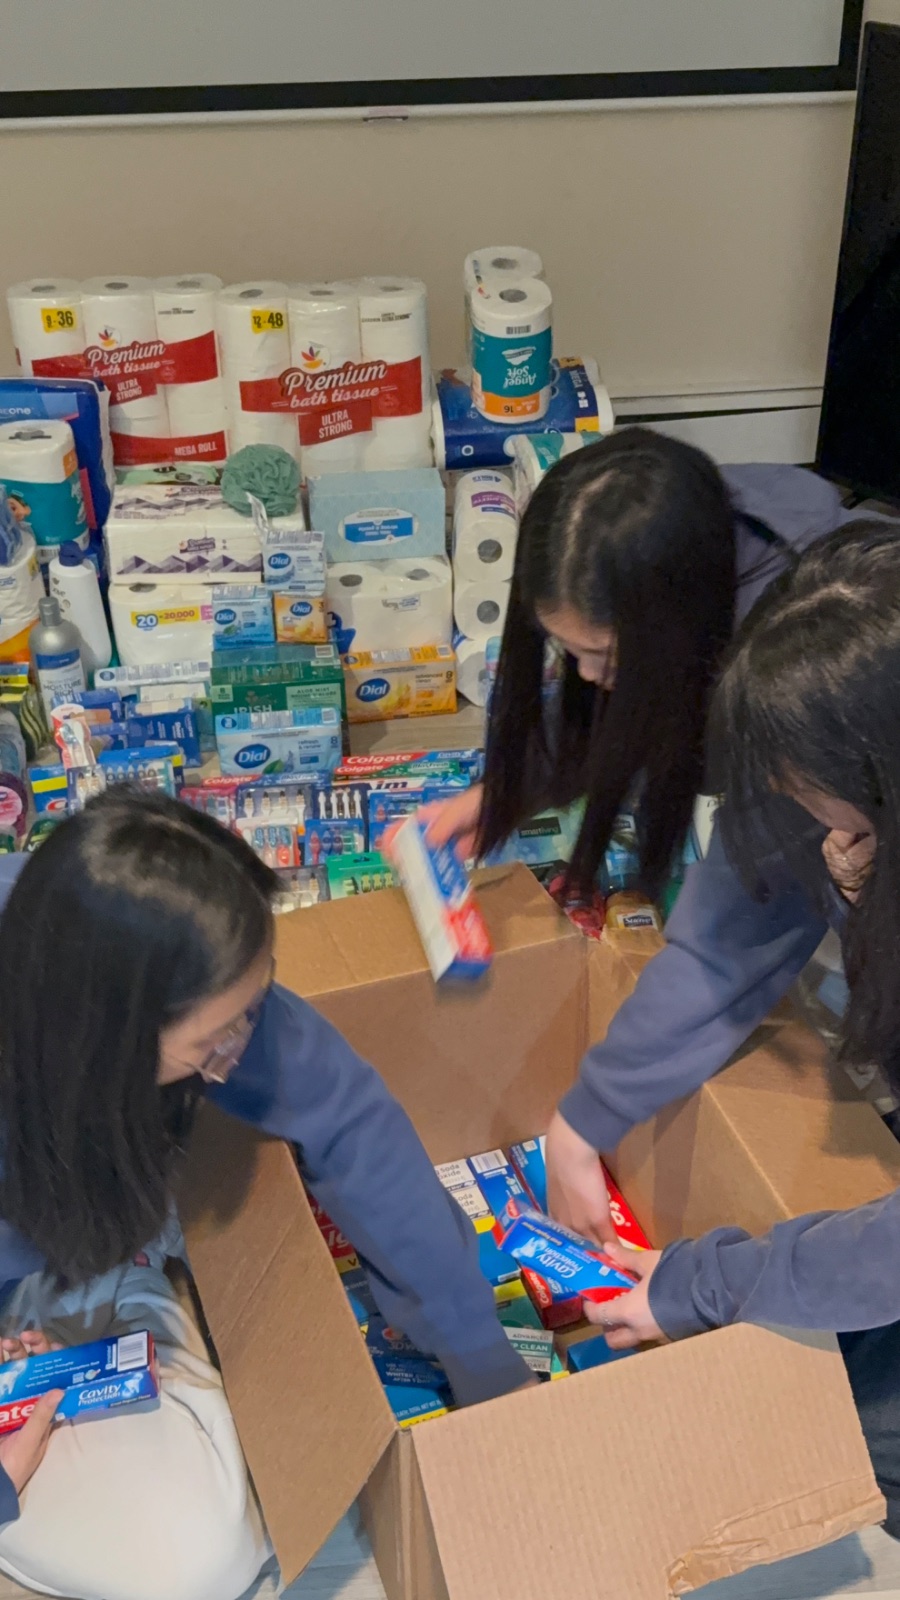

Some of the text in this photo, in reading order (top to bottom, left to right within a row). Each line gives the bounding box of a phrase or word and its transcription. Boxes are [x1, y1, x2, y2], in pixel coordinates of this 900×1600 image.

[57, 311, 74, 326] 36
[253, 312, 283, 327] 12 48
[87, 340, 166, 366] Premium
[93, 360, 161, 378] bath tissue
[507, 365, 530, 377] Soft
[116, 378, 139, 392] ULTRA
[284, 361, 388, 396] Premium
[503, 373, 536, 388] Angel
[116, 387, 142, 401] STRONG
[290, 385, 380, 408] bath tissue
[503, 405, 514, 413] 16
[321, 409, 349, 426] ULTRA
[318, 420, 353, 439] STRONG
[174, 441, 218, 456] MEGA ROLL
[270, 556, 289, 565] Dial
[216, 610, 235, 621] Dial
[292, 603, 311, 614] Dial
[136, 615, 157, 627] 20
[43, 679, 81, 690] MOISTURE
[359, 683, 388, 696] Dial
[233, 704, 272, 714] IRISH
[238, 749, 268, 763] Dial
[347, 753, 414, 765] Colgate
[336, 764, 384, 773] Colgate
[204, 776, 252, 785] Colgate
[375, 780, 408, 790] im
[457, 1193, 473, 1201] oda
[536, 1248, 577, 1279] Cavity
[528, 1272, 550, 1305] Colgate
[512, 1333, 549, 1341] ADVANCED
[519, 1343, 548, 1352] CLEAN
[78, 1383, 122, 1401] Cavity
[78, 1391, 121, 1407] Protection
[0, 1403, 35, 1423] ate
